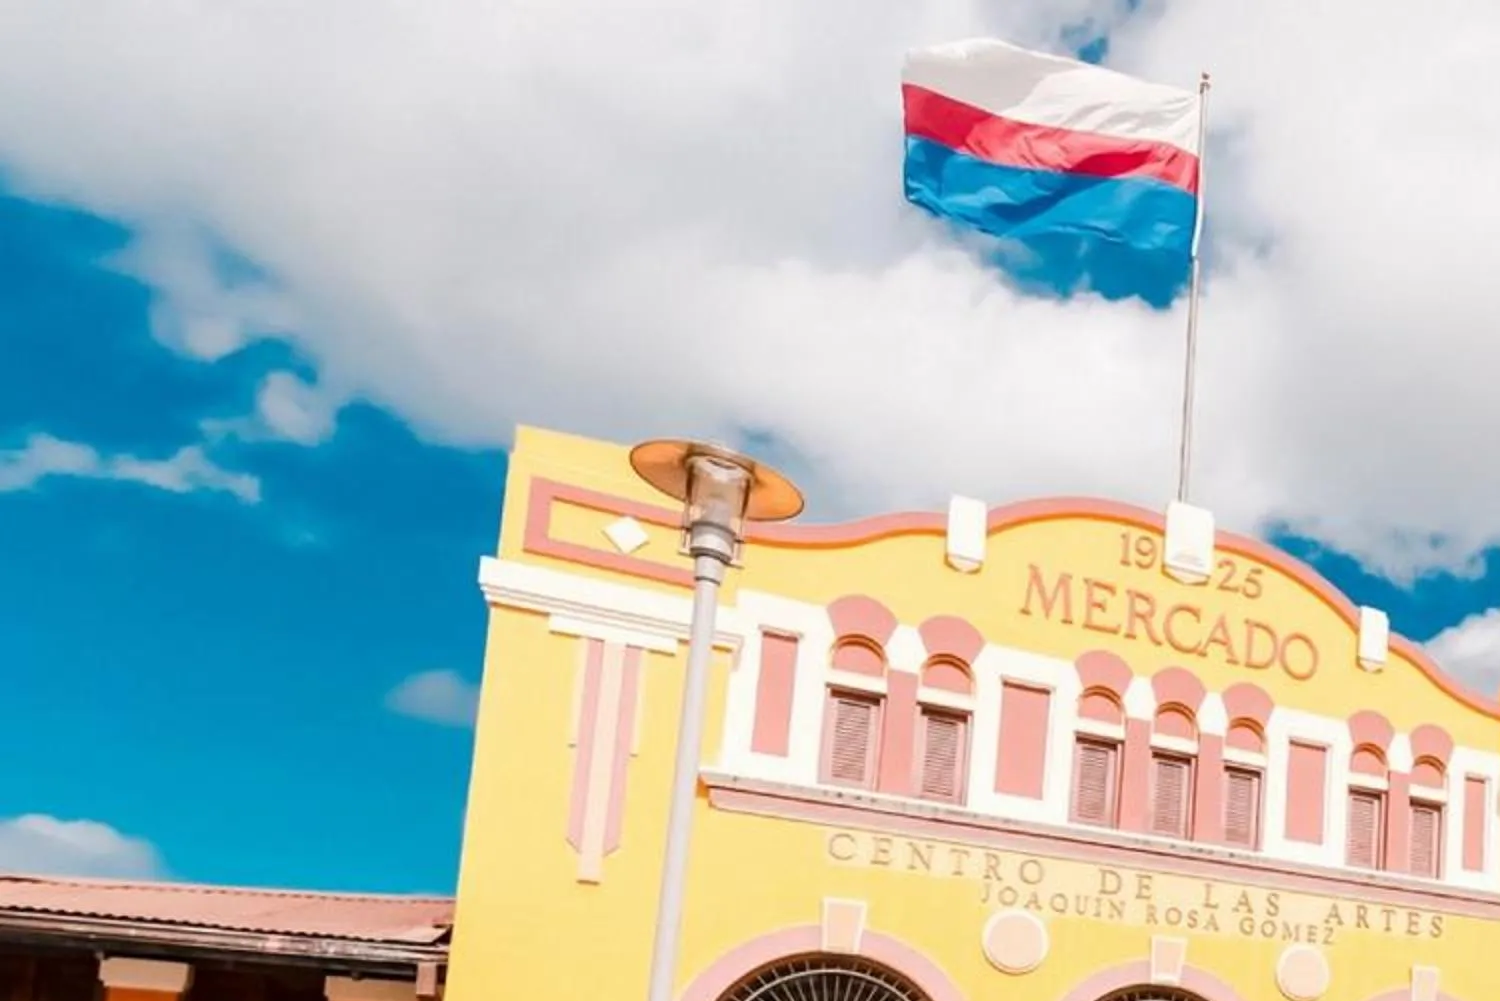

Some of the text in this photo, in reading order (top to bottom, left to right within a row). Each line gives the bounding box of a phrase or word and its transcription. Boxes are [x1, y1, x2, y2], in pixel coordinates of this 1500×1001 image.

[1121, 532, 1263, 599] 19 25
[1019, 564, 1319, 681] MERCADO
[829, 832, 1444, 939] CENTRO DE LAS ARTES
[980, 882, 1335, 945] JOAQUIN ROSA GOMEZ
